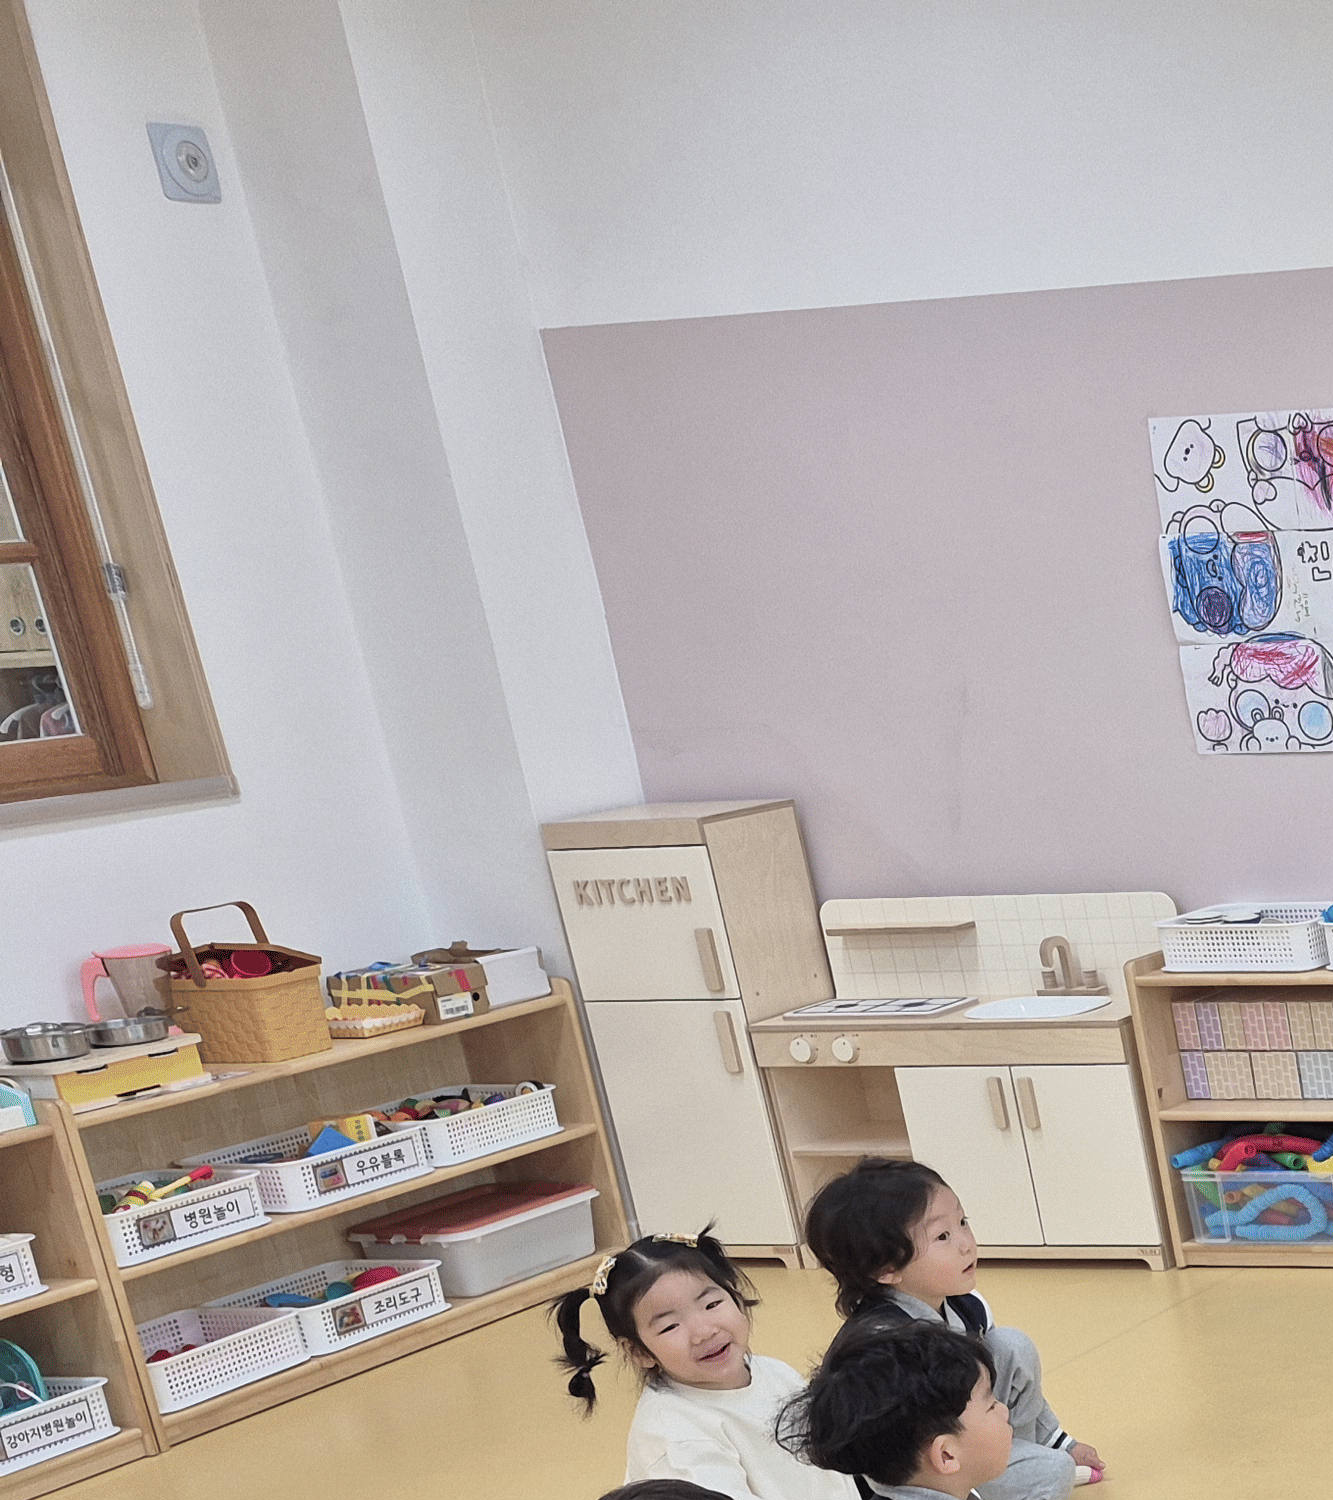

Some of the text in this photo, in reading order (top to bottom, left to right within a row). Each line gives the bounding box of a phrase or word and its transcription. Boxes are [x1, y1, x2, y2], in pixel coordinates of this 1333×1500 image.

[572, 876, 692, 906] KITCHEN
[356, 1149, 406, 1175] 우유블록
[184, 1199, 241, 1229] 병원놀이
[374, 1287, 422, 1316] 조리도구
[6, 1412, 87, 1448] 강아지병원놀이
